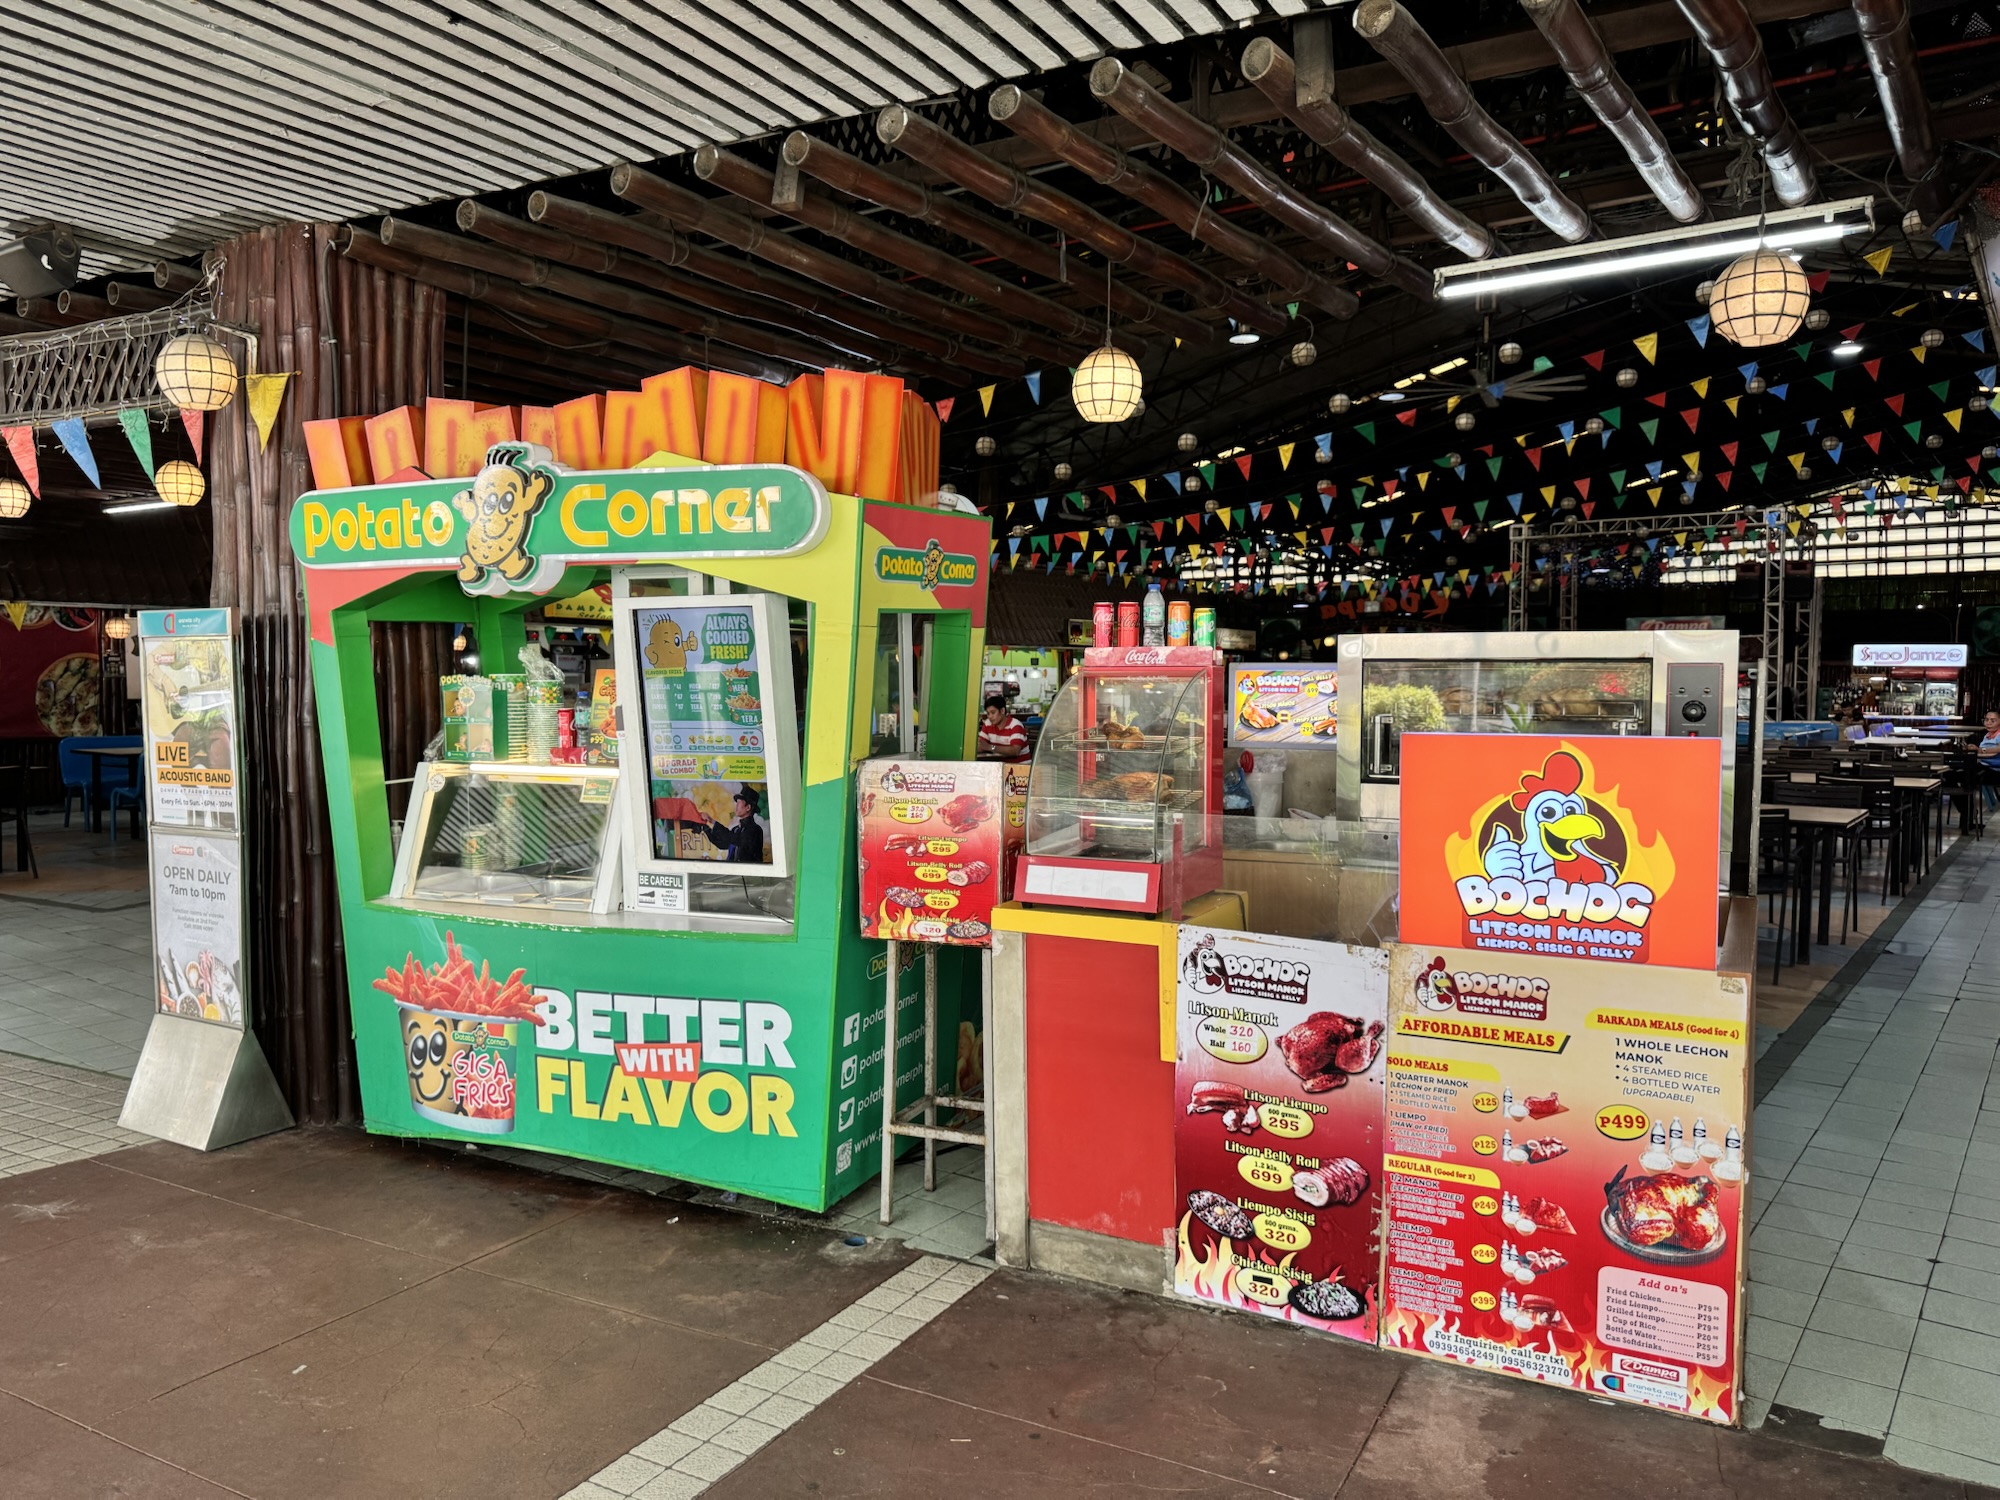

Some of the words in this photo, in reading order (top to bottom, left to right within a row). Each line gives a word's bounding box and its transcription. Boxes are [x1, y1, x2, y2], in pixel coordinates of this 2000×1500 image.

[303, 499, 454, 558] Potato
[559, 484, 781, 547] Corner
[707, 616, 747, 630] ALWAYS
[706, 631, 749, 644] COOKED
[710, 646, 748, 659] FRESH!
[1125, 649, 1167, 665] Coca-Cola
[1256, 676, 1300, 686] BOCHOG
[158, 746, 187, 762] LIVE
[658, 757, 697, 768] UPGRADE
[160, 771, 202, 782] ACOUSTIC
[205, 773, 230, 783] BAND
[905, 773, 956, 784] BOCHOG
[161, 798, 174, 806] Every
[163, 866, 194, 881] OPEN
[198, 870, 231, 885] DAILY
[640, 875, 649, 884] BE
[650, 876, 682, 887] CAREFUL
[169, 884, 188, 896] 7am
[190, 888, 199, 897] to
[202, 888, 225, 902] 10pm
[1455, 875, 1654, 928] BOCHOG
[1468, 919, 1551, 940] LITSON
[1558, 926, 1643, 947] MANOK
[1536, 942, 1572, 955] SISIG
[1578, 946, 1586, 956] &
[1590, 947, 1635, 960] BELLY
[1223, 954, 1311, 985] BOCHOG
[1228, 978, 1265, 989] LITSON
[1267, 983, 1305, 995] MANOK
[1453, 971, 1550, 1002] BOCHOG
[1460, 995, 1500, 1007] LITSON
[1503, 1000, 1543, 1011] MANOK
[1188, 1000, 1229, 1019] Litson
[1232, 1006, 1278, 1027] Manok
[534, 986, 797, 1069] BETTER
[1204, 1024, 1226, 1034] Whole
[1230, 1026, 1253, 1037] 320
[1402, 1019, 1499, 1041] AFFORDABLE
[1503, 1030, 1555, 1047] MEALS
[1597, 1014, 1647, 1028] BARKADA
[1650, 1020, 1684, 1032] MEALS
[1686, 1024, 1712, 1035] (Good
[1715, 1028, 1728, 1036] for
[1730, 1029, 1740, 1039] 4)
[1210, 1040, 1225, 1048] Half
[1232, 1041, 1251, 1052] 160
[1615, 1038, 1620, 1046] 1
[1624, 1038, 1671, 1052] WHOLE
[1675, 1044, 1728, 1058] LECHON
[619, 1047, 695, 1073] WITH
[1386, 1056, 1412, 1067] SOLO
[1414, 1060, 1449, 1072] MEALS
[1615, 1051, 1663, 1064] MANOK
[453, 1051, 508, 1082] GIGA
[1632, 1066, 1681, 1078] STEAMED
[1684, 1071, 1708, 1081] RICE
[1395, 1072, 1434, 1084] QUARTER
[1437, 1079, 1468, 1088] MANOK
[1632, 1077, 1679, 1090] BOTTLED
[1682, 1083, 1720, 1094] WATER
[536, 1055, 798, 1138] FLAVOR
[1390, 1081, 1422, 1091] (LECHON
[1433, 1087, 1457, 1096] FRIED)
[1623, 1087, 1695, 1104] (UPGRADABLE)
[1244, 1089, 1280, 1105] Litson
[1284, 1096, 1328, 1114] Liempo
[1269, 1117, 1299, 1131] 295
[1395, 1112, 1426, 1121] LIEMPO
[1600, 1114, 1646, 1129] P499
[1424, 1126, 1448, 1134] FRIED)
[1225, 1140, 1260, 1157] Litson
[1264, 1147, 1293, 1165] Belly
[1296, 1154, 1319, 1169] Roll
[1388, 1159, 1431, 1173] REGULAR
[1434, 1168, 1454, 1177] (Good
[1251, 1169, 1282, 1184] 699
[1391, 1174, 1402, 1182] 1/2
[1405, 1177, 1438, 1188] MANOK
[1391, 1184, 1425, 1194] (LECHON
[1438, 1192, 1463, 1202] FRIED)
[1237, 1197, 1281, 1216] Liempo
[1285, 1208, 1315, 1226] Sisig
[1265, 1228, 1296, 1244] 320
[1397, 1222, 1431, 1234] LIEMPO
[1231, 1254, 1279, 1275] Chicken
[1283, 1266, 1313, 1285] Sisig
[1390, 1267, 1424, 1279] LIEMPO
[1442, 1279, 1462, 1287] grms
[1249, 1283, 1279, 1298] 320
[1638, 1278, 1660, 1289] Add
[1664, 1284, 1688, 1294] on's
[1612, 1316, 1627, 1325] Cup
[1435, 1330, 1451, 1342] For
[1455, 1334, 1508, 1354] Inquiries,
[1511, 1348, 1532, 1358] call
[1550, 1355, 1564, 1365] txt
[1429, 1340, 1494, 1361] 09393654249
[1501, 1356, 1570, 1378] 09556323770
[1632, 1361, 1678, 1377] Dampa
[1627, 1382, 1662, 1394] araneta
[1665, 1390, 1683, 1399] city
